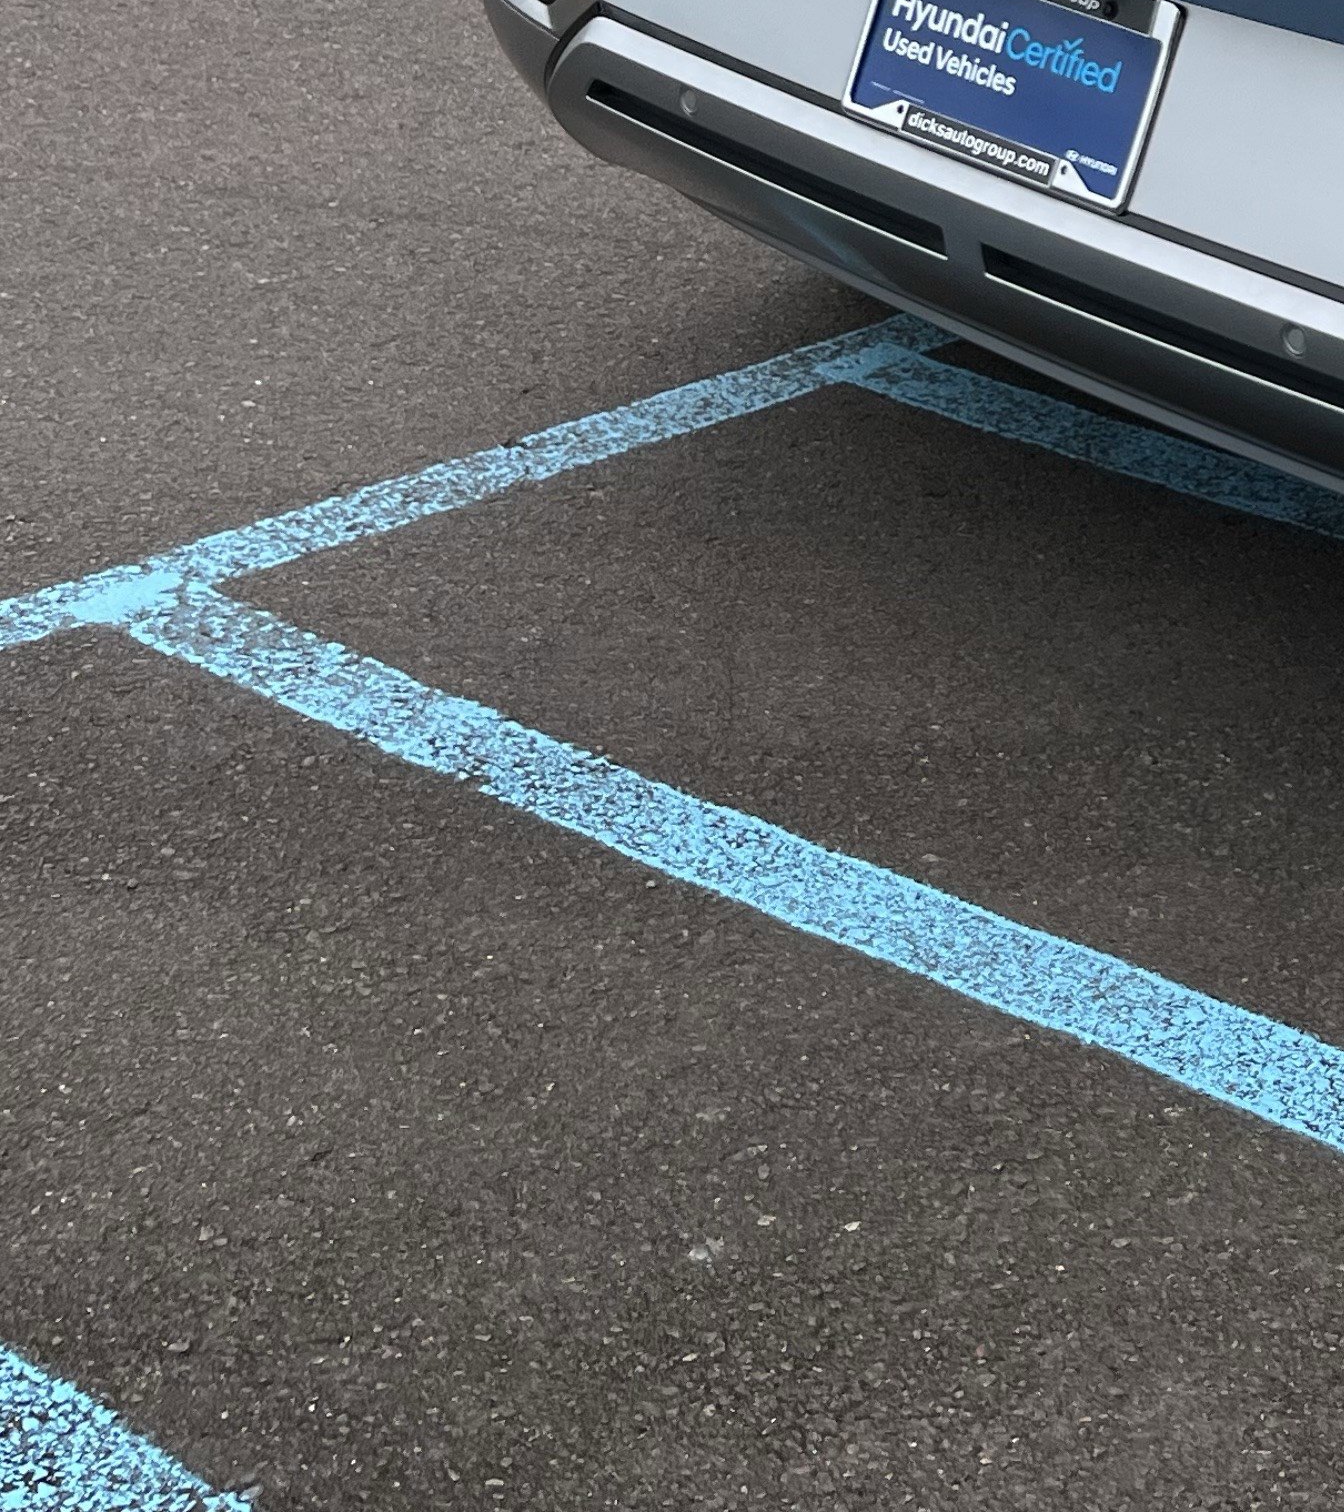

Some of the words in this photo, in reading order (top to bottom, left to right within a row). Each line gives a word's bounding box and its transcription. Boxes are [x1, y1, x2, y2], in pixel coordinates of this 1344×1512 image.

[883, 27, 936, 66] Used
[935, 44, 1017, 96] Vehicles
[907, 111, 1050, 176] dicksautogroup.com
